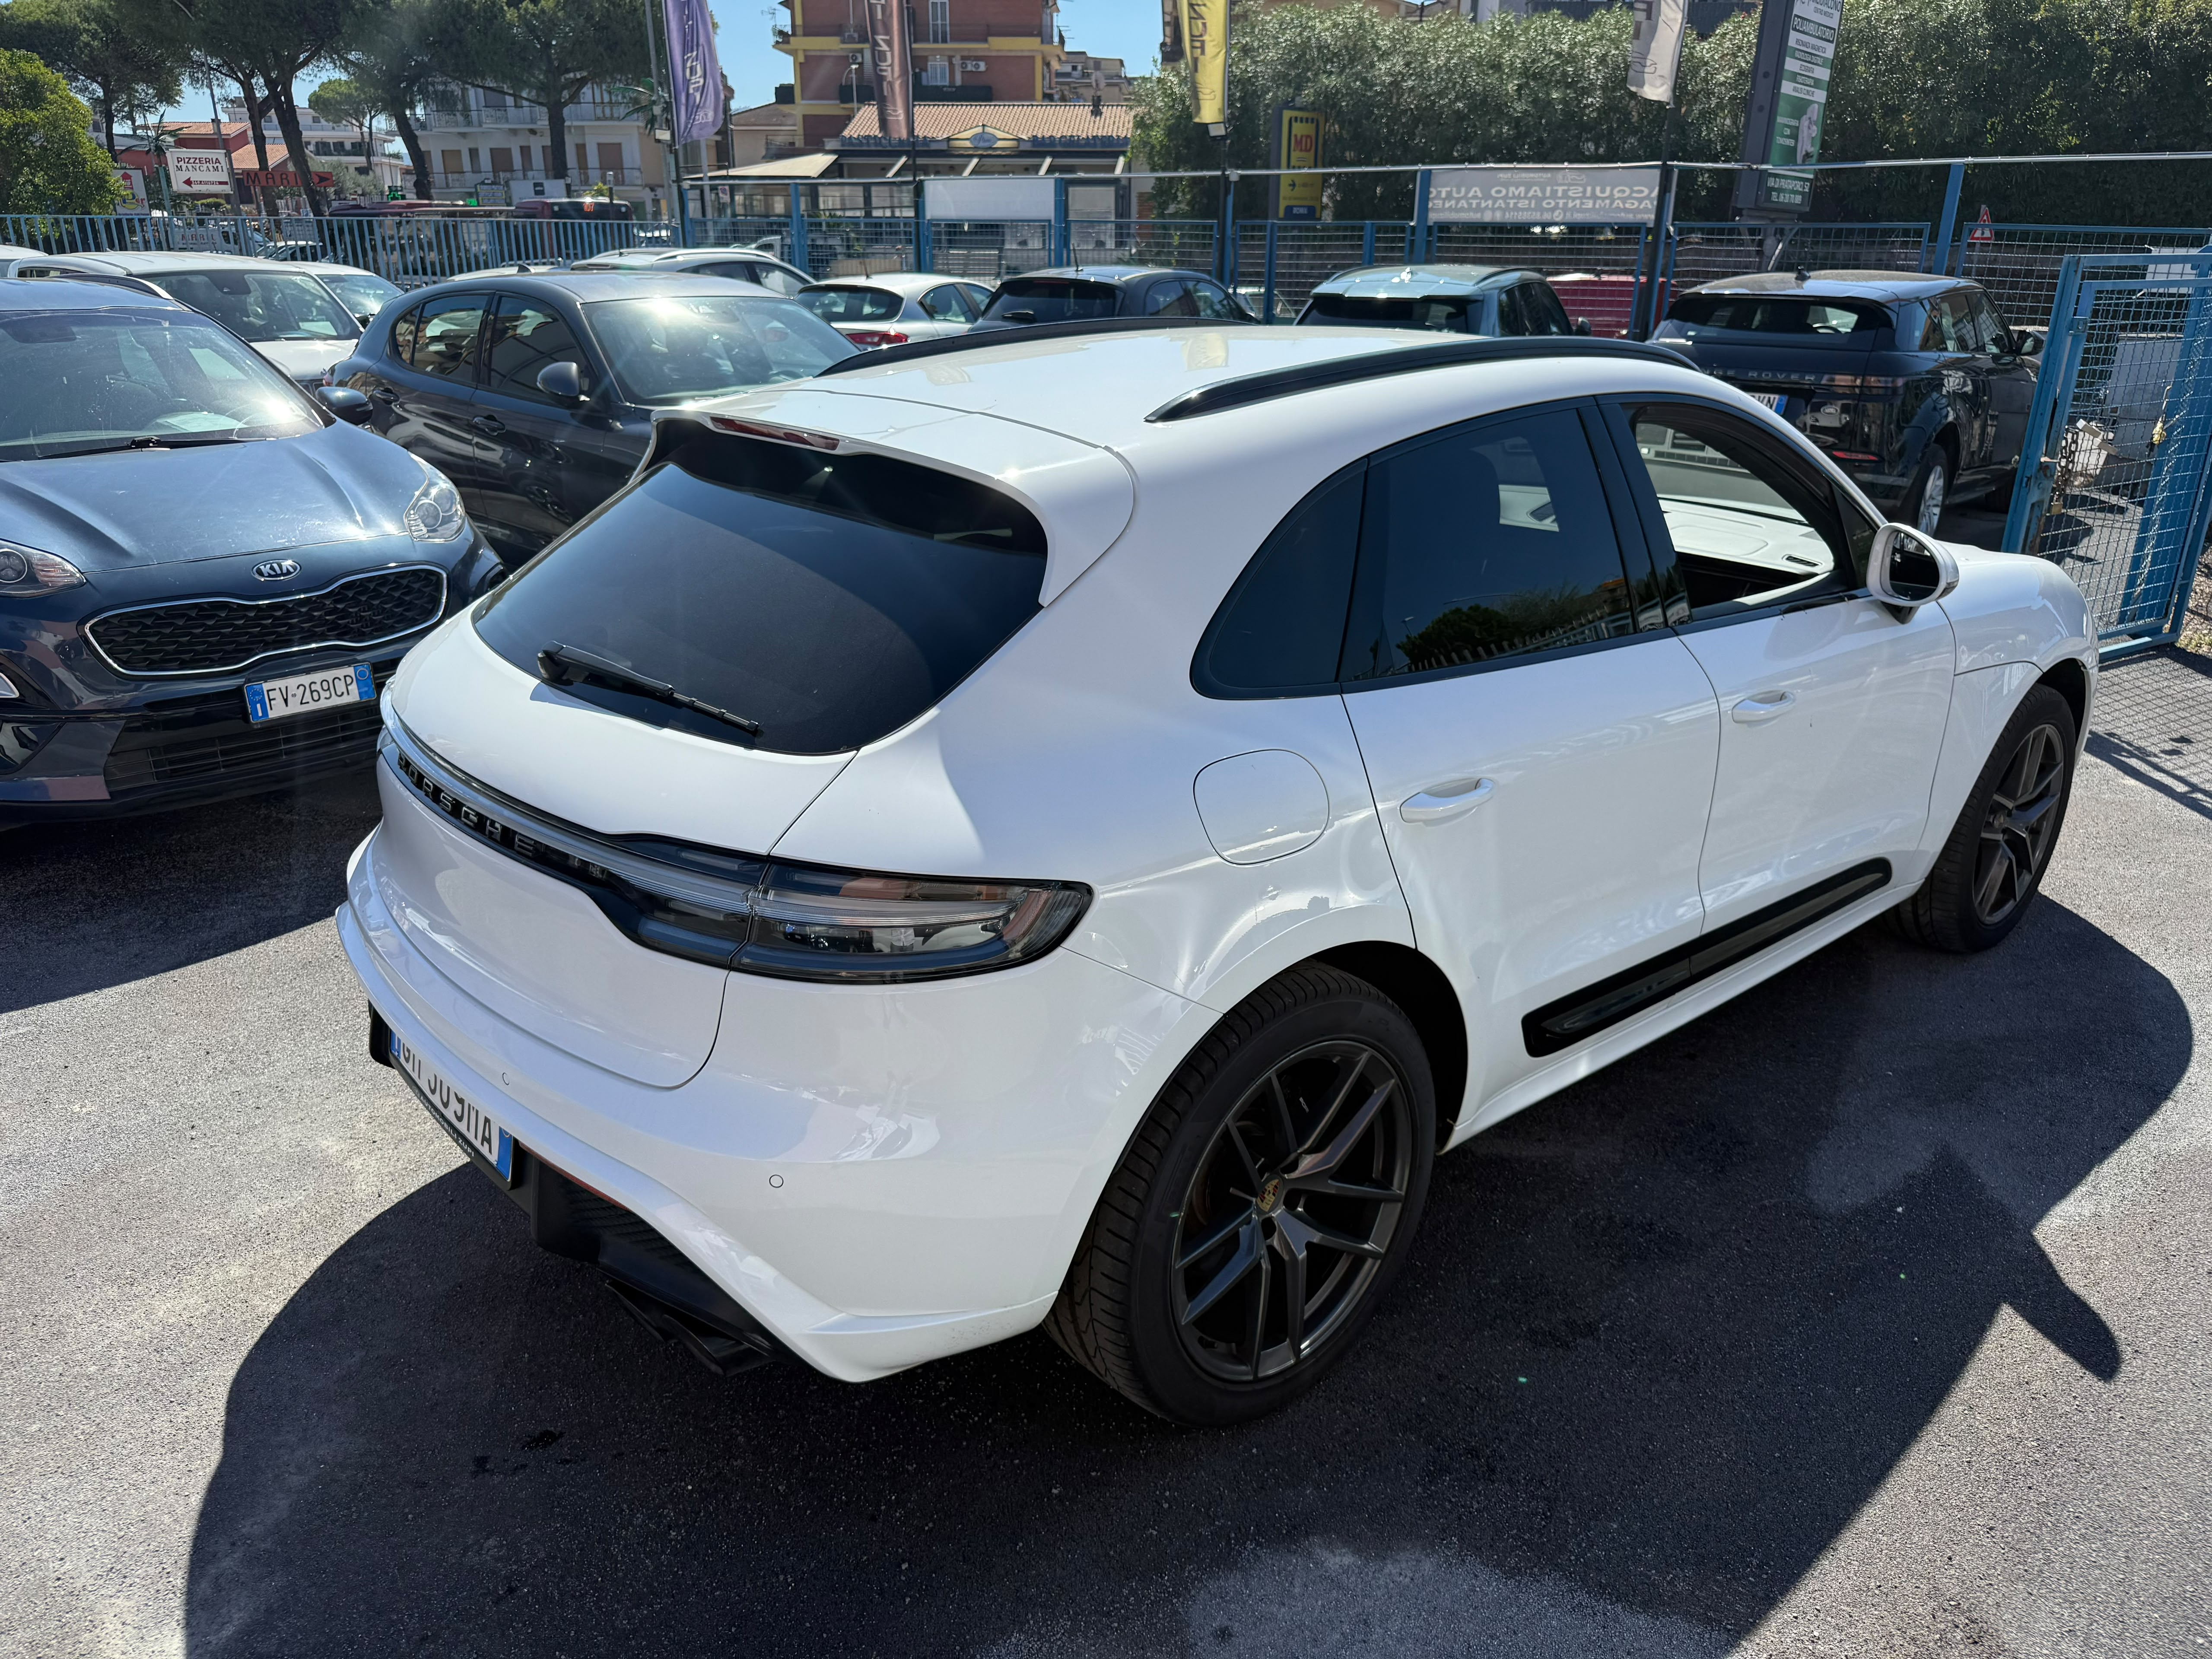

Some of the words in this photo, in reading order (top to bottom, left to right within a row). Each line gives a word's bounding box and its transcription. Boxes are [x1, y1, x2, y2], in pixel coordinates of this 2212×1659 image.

[1293, 135, 1313, 152] MD
[1748, 370, 1815, 381] ROVER
[259, 562, 295, 577] KIA
[397, 752, 536, 857] PORSCHE
[420, 1096, 457, 1139] AUTOMOBILI
[458, 1137, 474, 1157] ZUPI
